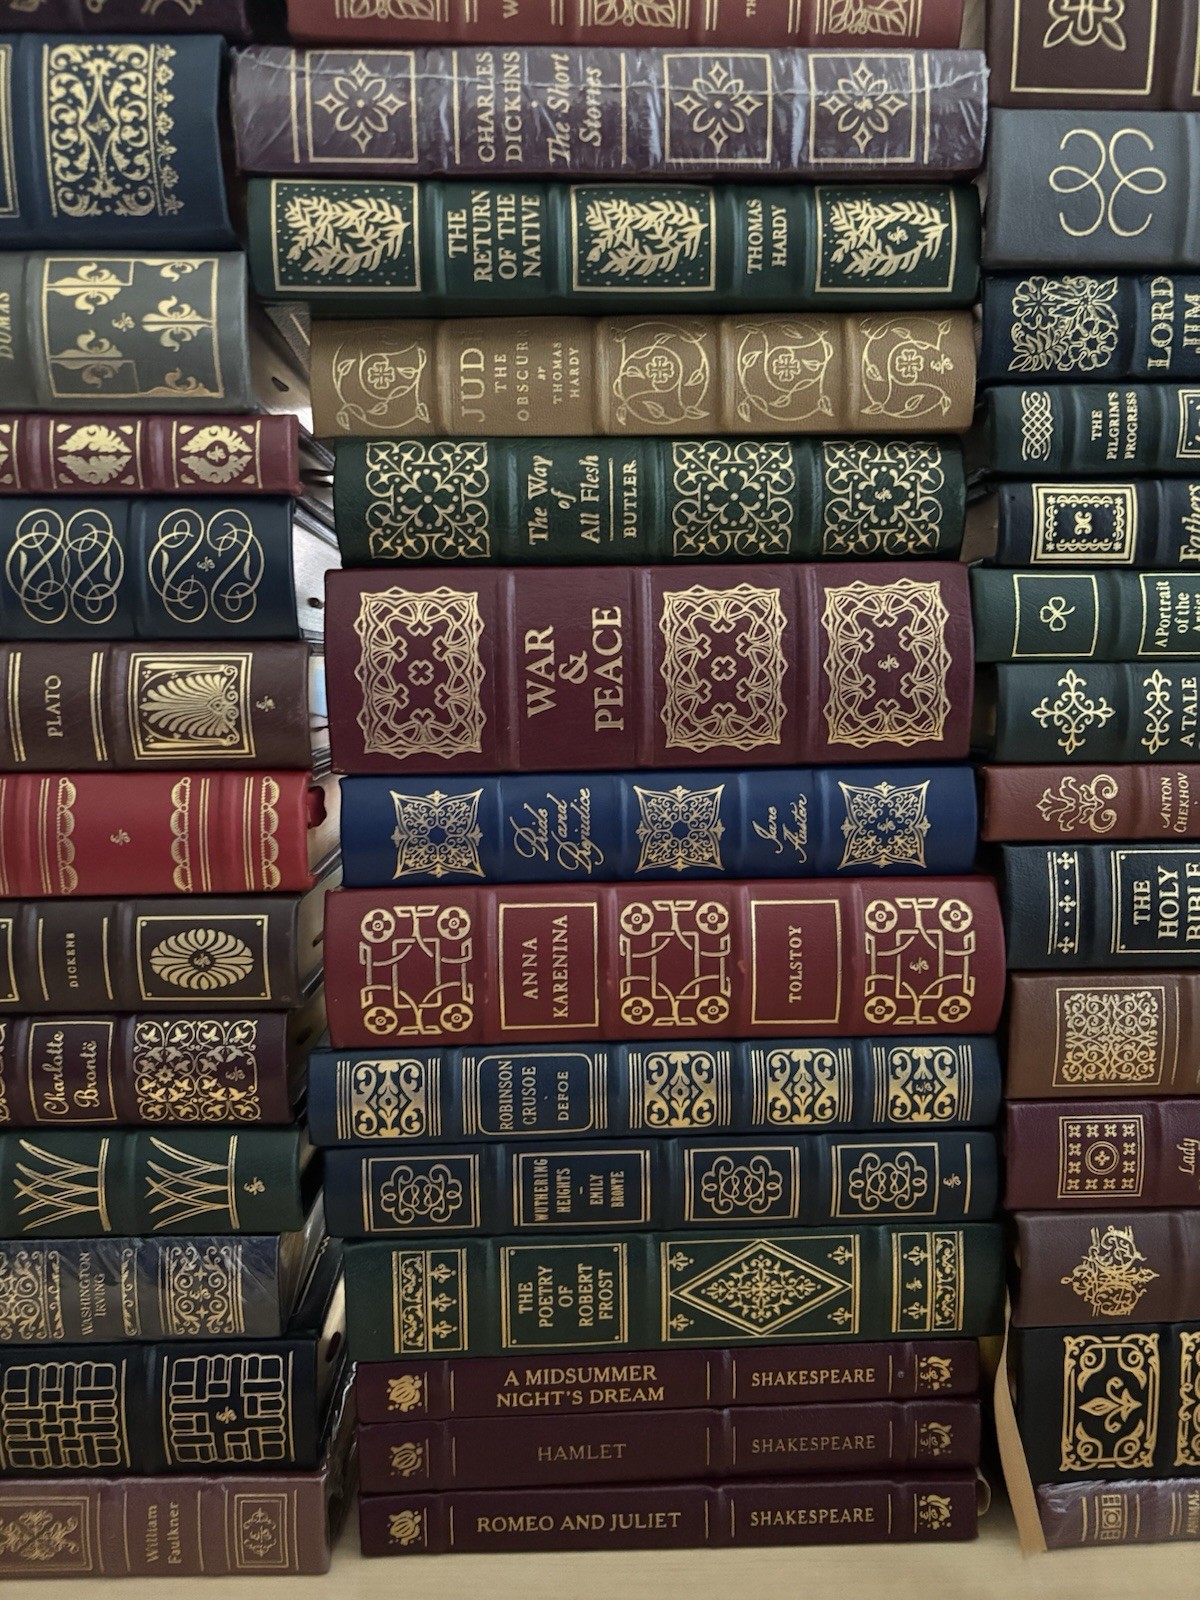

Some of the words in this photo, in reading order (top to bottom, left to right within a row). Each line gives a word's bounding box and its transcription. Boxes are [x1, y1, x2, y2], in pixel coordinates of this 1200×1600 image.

[476, 51, 496, 163] CHARLES
[502, 51, 523, 163] DICKENS
[547, 53, 570, 113] Short
[579, 66, 602, 147] Stories
[548, 121, 571, 164] The
[447, 209, 468, 259] THE
[471, 189, 493, 283] RETURN
[496, 193, 516, 240] THE
[521, 194, 541, 278] NATIVE
[746, 199, 763, 274] THOMAS
[771, 204, 787, 267] HARDY
[498, 247, 518, 280] OF
[1147, 276, 1175, 371] LORD
[494, 354, 507, 393] THE
[516, 330, 530, 421] OBSCUR
[553, 342, 562, 404] THOMAS
[569, 347, 579, 398] HARDY
[1091, 410, 1103, 441] THE
[1106, 391, 1120, 460] PILGRIM'S
[1124, 391, 1138, 460] PROGRESS
[528, 455, 553, 500] Way
[551, 487, 577, 510] of
[579, 454, 600, 502] Flesh
[623, 459, 637, 539] BUTLER
[528, 506, 548, 546] The
[580, 512, 600, 544] All
[1155, 580, 1172, 637] Portrait
[1174, 617, 1189, 634] of
[1175, 592, 1190, 615] the
[558, 650, 588, 685] &
[591, 605, 624, 732] PEACE
[1155, 638, 1168, 648] A
[524, 624, 557, 719] WAR
[44, 674, 63, 738] PLATO
[1181, 677, 1198, 731] TALE
[1179, 732, 1196, 748] A
[546, 792, 568, 839] and
[782, 793, 808, 864] Austen
[1160, 776, 1172, 829] ANTON
[1173, 772, 1190, 833] CHEKHOV
[509, 802, 549, 862] Pride
[551, 787, 605, 875] Prejudice
[752, 820, 783, 854] Jane
[1133, 880, 1151, 926] THE
[1157, 864, 1180, 939] HOLY
[65, 932, 79, 988] DICKENS
[522, 937, 538, 1000] ANNA
[551, 914, 569, 1018] KARENINA
[788, 925, 803, 1004] TOLSTOY
[41, 1030, 69, 1114] Charlotte
[74, 1040, 100, 1108] Brontë
[498, 1060, 514, 1130] ROBINSON
[521, 1066, 537, 1126] CRUSOE
[557, 1071, 570, 1121] DEFOE
[533, 1158, 549, 1222] WUTHERING
[556, 1167, 571, 1213] HEIGHTS
[590, 1174, 604, 1206] EMILY
[79, 1252, 94, 1336] WASHINGTON
[94, 1273, 106, 1317] IRVING
[518, 1281, 533, 1314] THE
[538, 1265, 554, 1328] POETRY
[558, 1285, 574, 1308] OF
[577, 1263, 594, 1327] ROBERT
[598, 1268, 614, 1320] FROST
[496, 1389, 584, 1408] NIGHT'S
[589, 1386, 665, 1405] DREAM
[504, 1369, 520, 1387] A
[525, 1365, 658, 1386] MIDSUMMER
[751, 1368, 876, 1388] SHAKESPEARE
[537, 1443, 627, 1462] HAMLET
[752, 1435, 876, 1454] SHAKESPEARE
[145, 1504, 159, 1562] William
[167, 1501, 182, 1564] Faulkner
[477, 1515, 554, 1533] ROMEO
[560, 1513, 605, 1531] AND
[609, 1512, 682, 1532] JULIET
[750, 1507, 875, 1527] SHAKESPEARE
